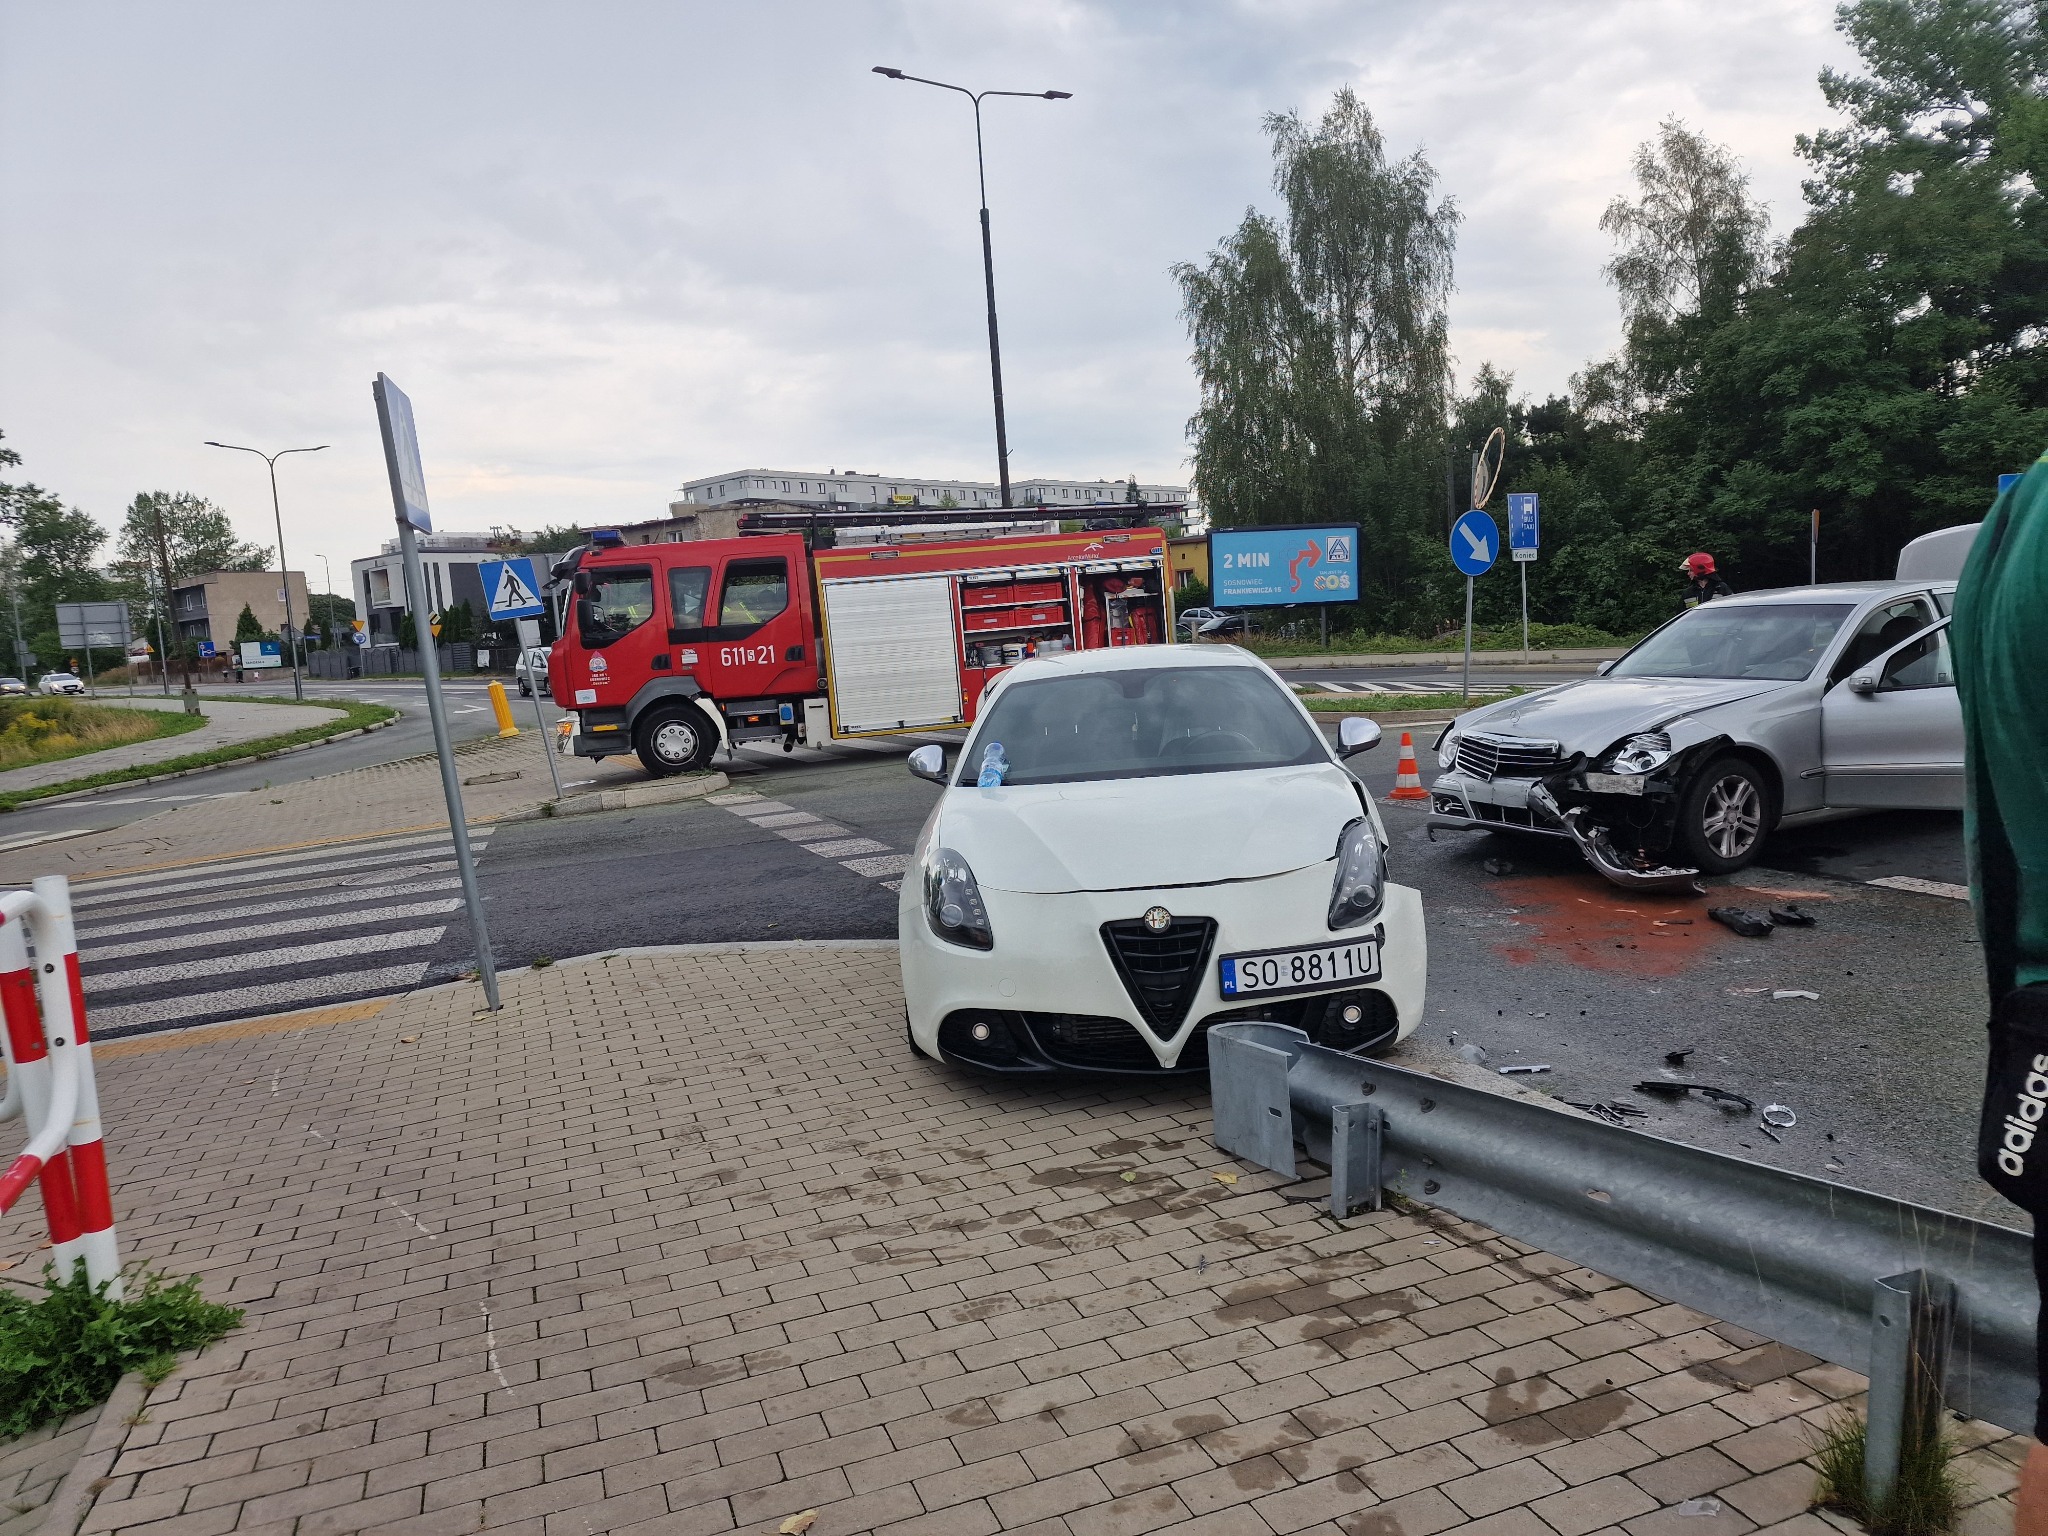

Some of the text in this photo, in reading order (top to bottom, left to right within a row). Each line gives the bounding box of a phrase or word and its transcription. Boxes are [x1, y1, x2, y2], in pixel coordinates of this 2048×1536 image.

[1523, 515, 1534, 523] BUS
[1514, 551, 1535, 559] Koniec
[1223, 552, 1270, 569] 2 MIN
[1223, 578, 1263, 587] SOSNOWIEC
[1223, 586, 1273, 595] FRANKIEWICZA
[1242, 945, 1372, 989] SO 8811U
[1224, 981, 1235, 989] PL
